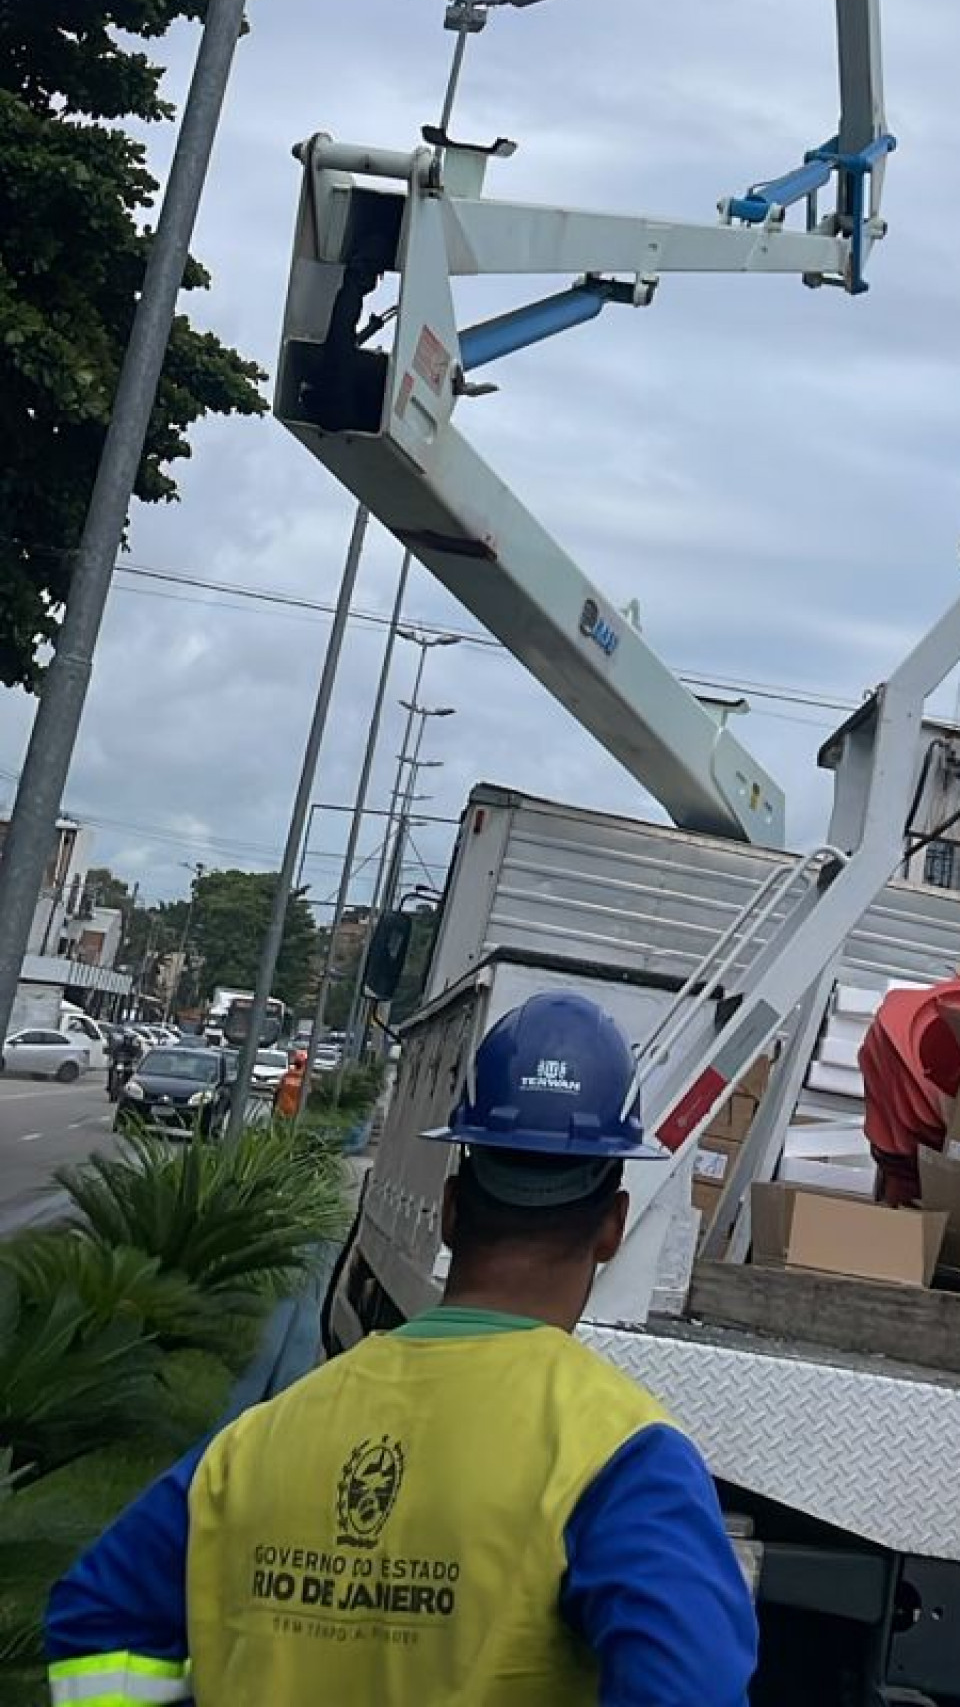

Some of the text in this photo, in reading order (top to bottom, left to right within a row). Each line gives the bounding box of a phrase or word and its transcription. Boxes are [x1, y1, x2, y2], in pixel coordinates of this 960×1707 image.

[255, 1544, 346, 1576] GOVERNO
[382, 1559, 460, 1583] ESTADO
[253, 1570, 295, 1602] RIO
[302, 1576, 335, 1608] DE
